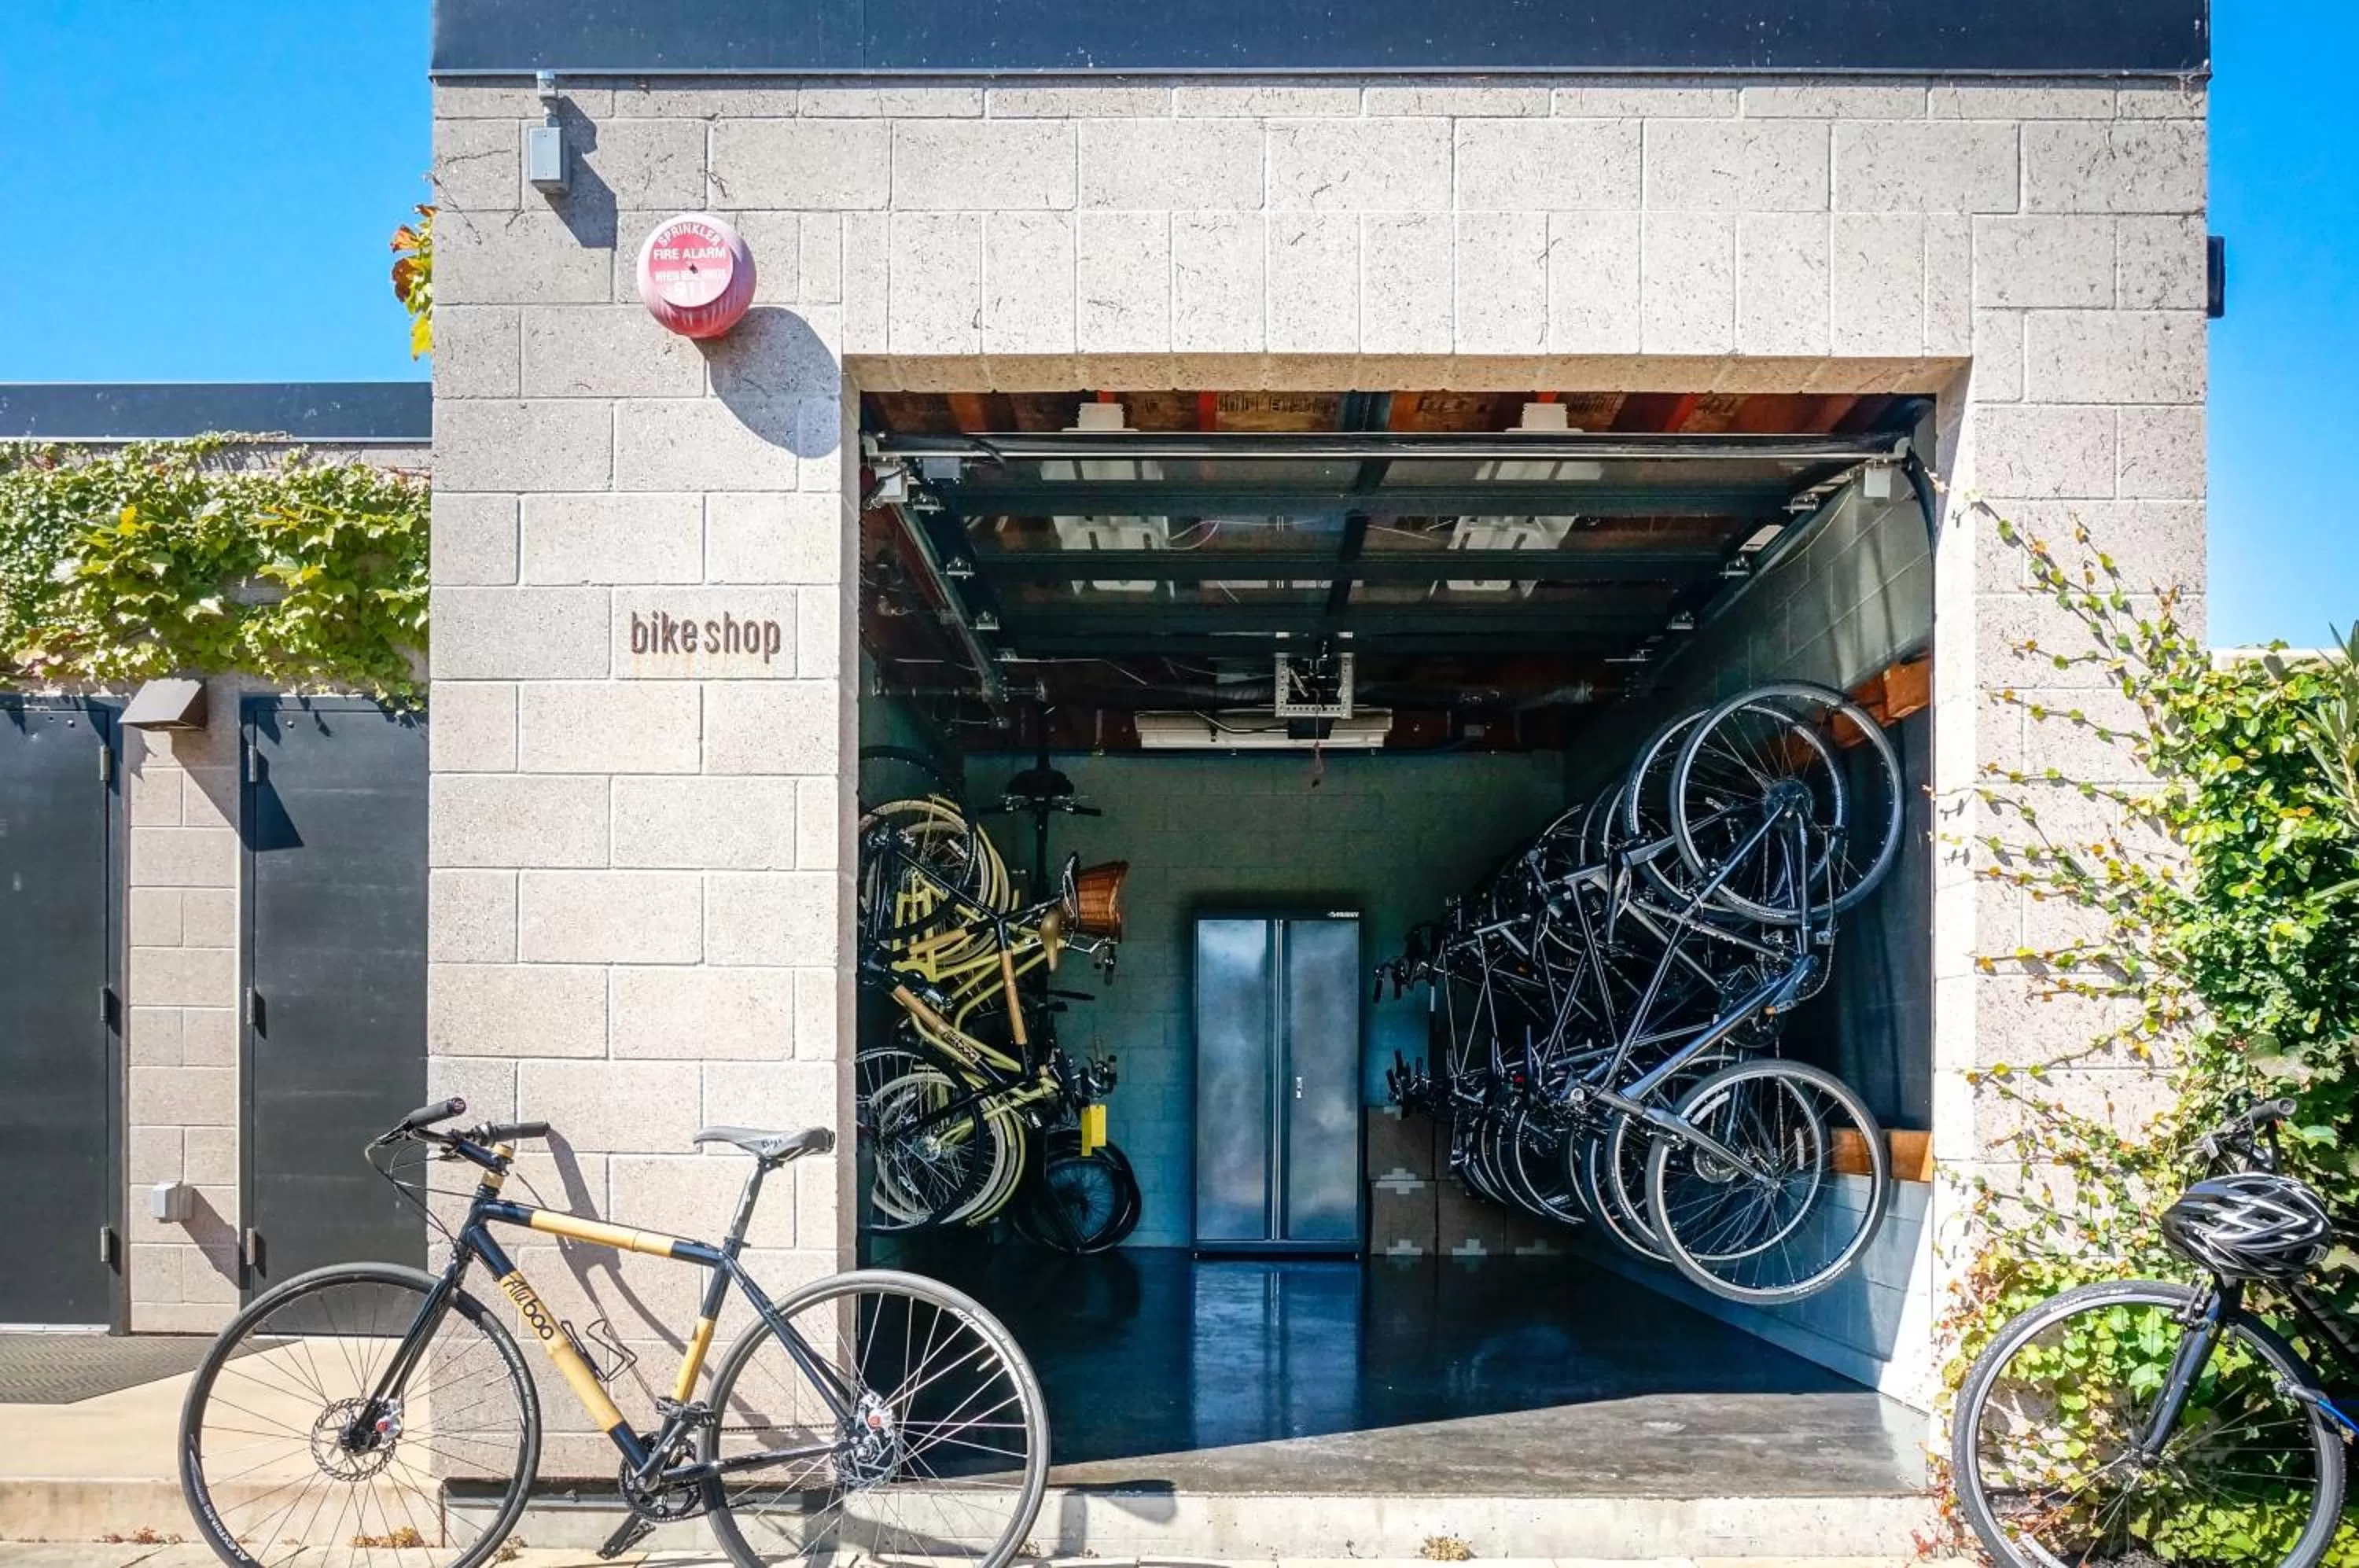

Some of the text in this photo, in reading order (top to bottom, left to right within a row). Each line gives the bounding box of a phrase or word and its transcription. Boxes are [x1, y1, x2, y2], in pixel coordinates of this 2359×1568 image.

[657, 223, 722, 246] SPRINKLER
[653, 247, 726, 260] FIRE ALARM
[631, 610, 782, 664] bike shop
